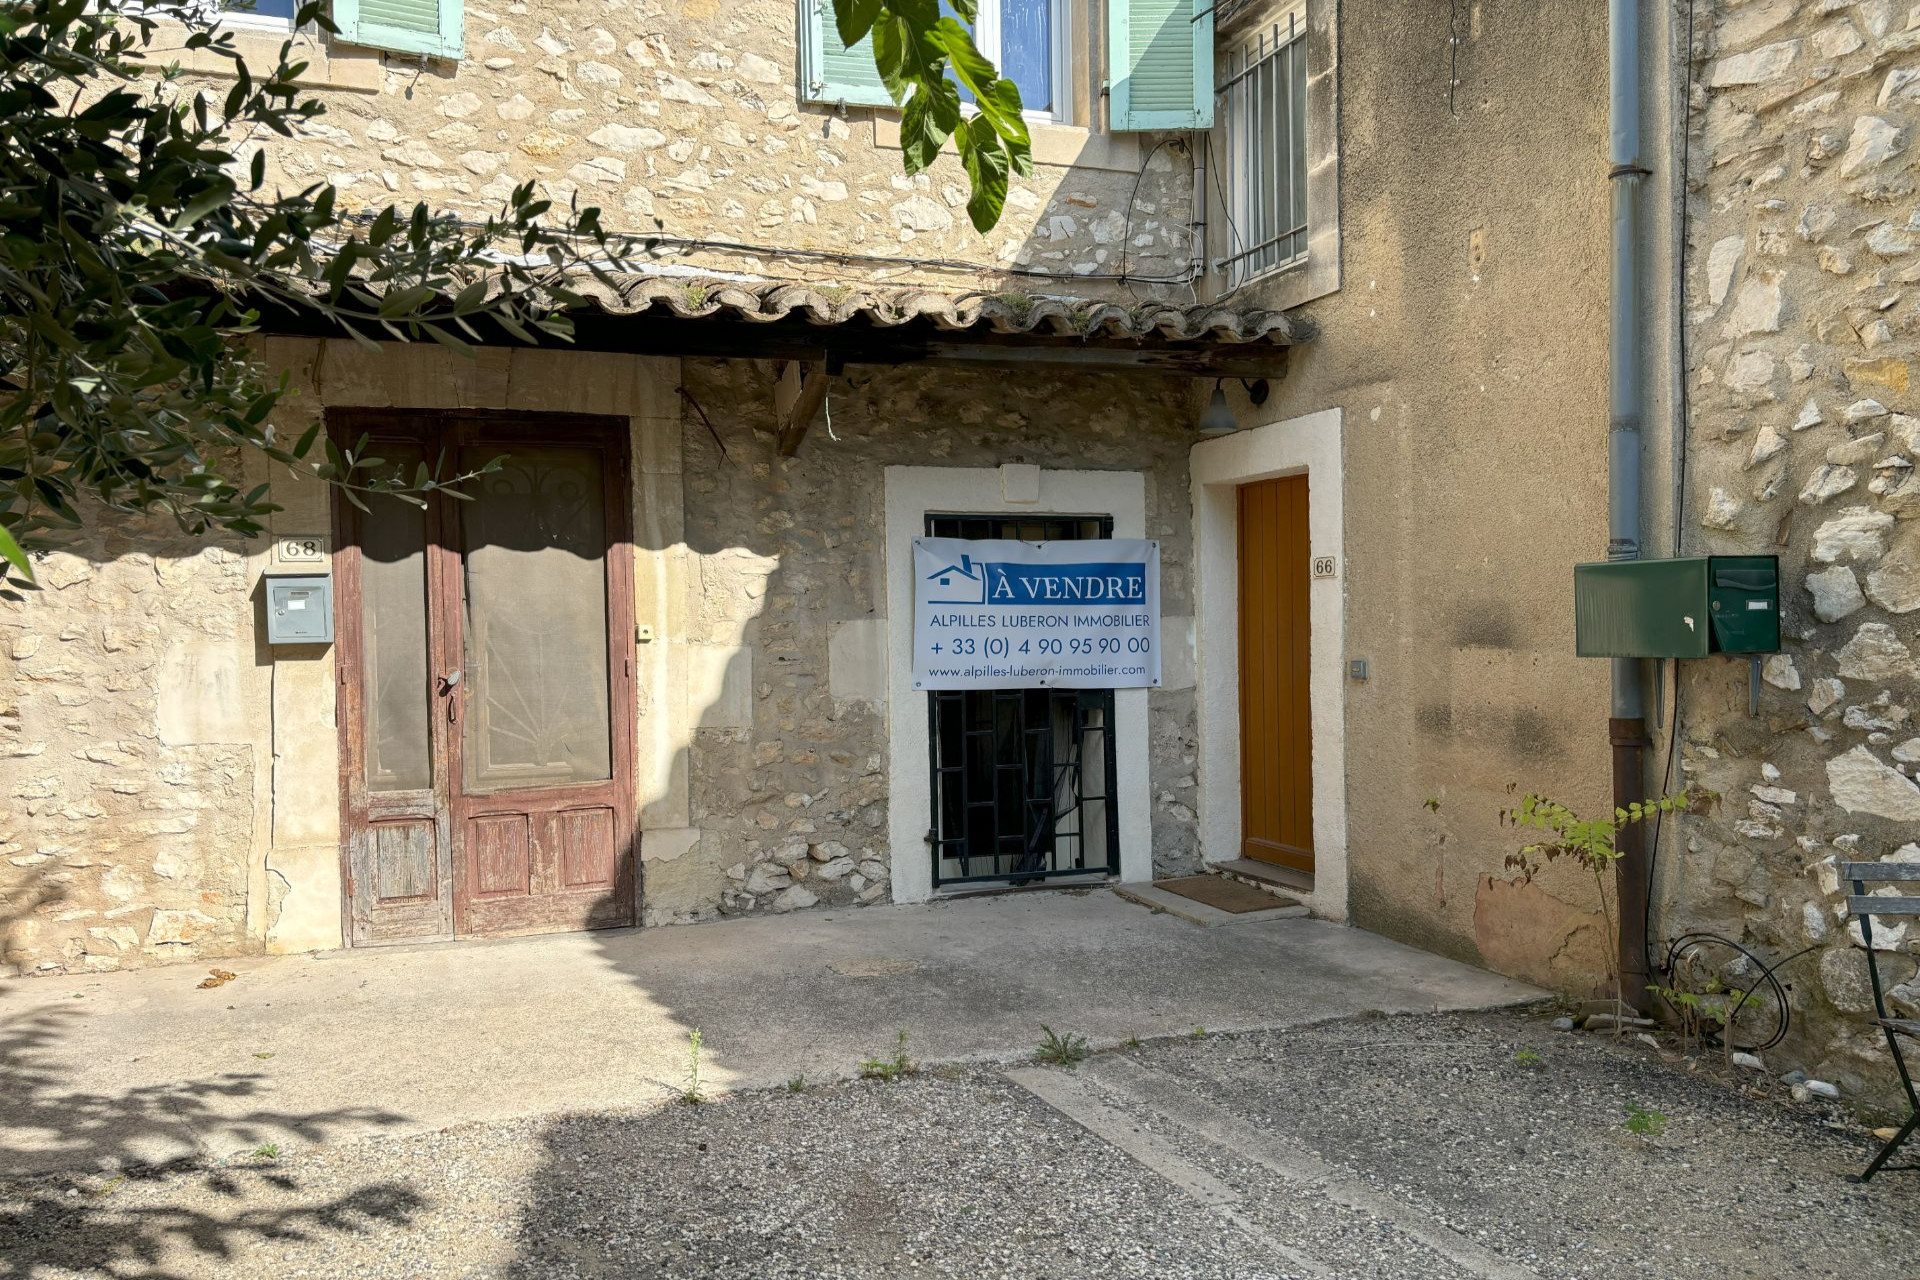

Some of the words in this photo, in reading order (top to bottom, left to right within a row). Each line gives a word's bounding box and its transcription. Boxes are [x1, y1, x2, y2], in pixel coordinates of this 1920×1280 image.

[286, 541, 316, 556] 68
[1316, 560, 1332, 574] 66
[992, 569, 1015, 599] À
[1018, 576, 1142, 599] VENDRE
[930, 614, 996, 628] ALPILLES
[1002, 614, 1069, 628] LUBERON
[1074, 614, 1150, 627] IMMOBILIER
[931, 642, 943, 655] +
[952, 638, 976, 655] 33
[984, 637, 1009, 658] (0)
[1018, 638, 1031, 655] 4
[1038, 638, 1063, 654] 90
[1069, 638, 1092, 654] 95
[1098, 638, 1121, 654] 90
[1127, 637, 1150, 653] 00
[928, 664, 1146, 679] www.alpilles-luberon-immobilier.com
